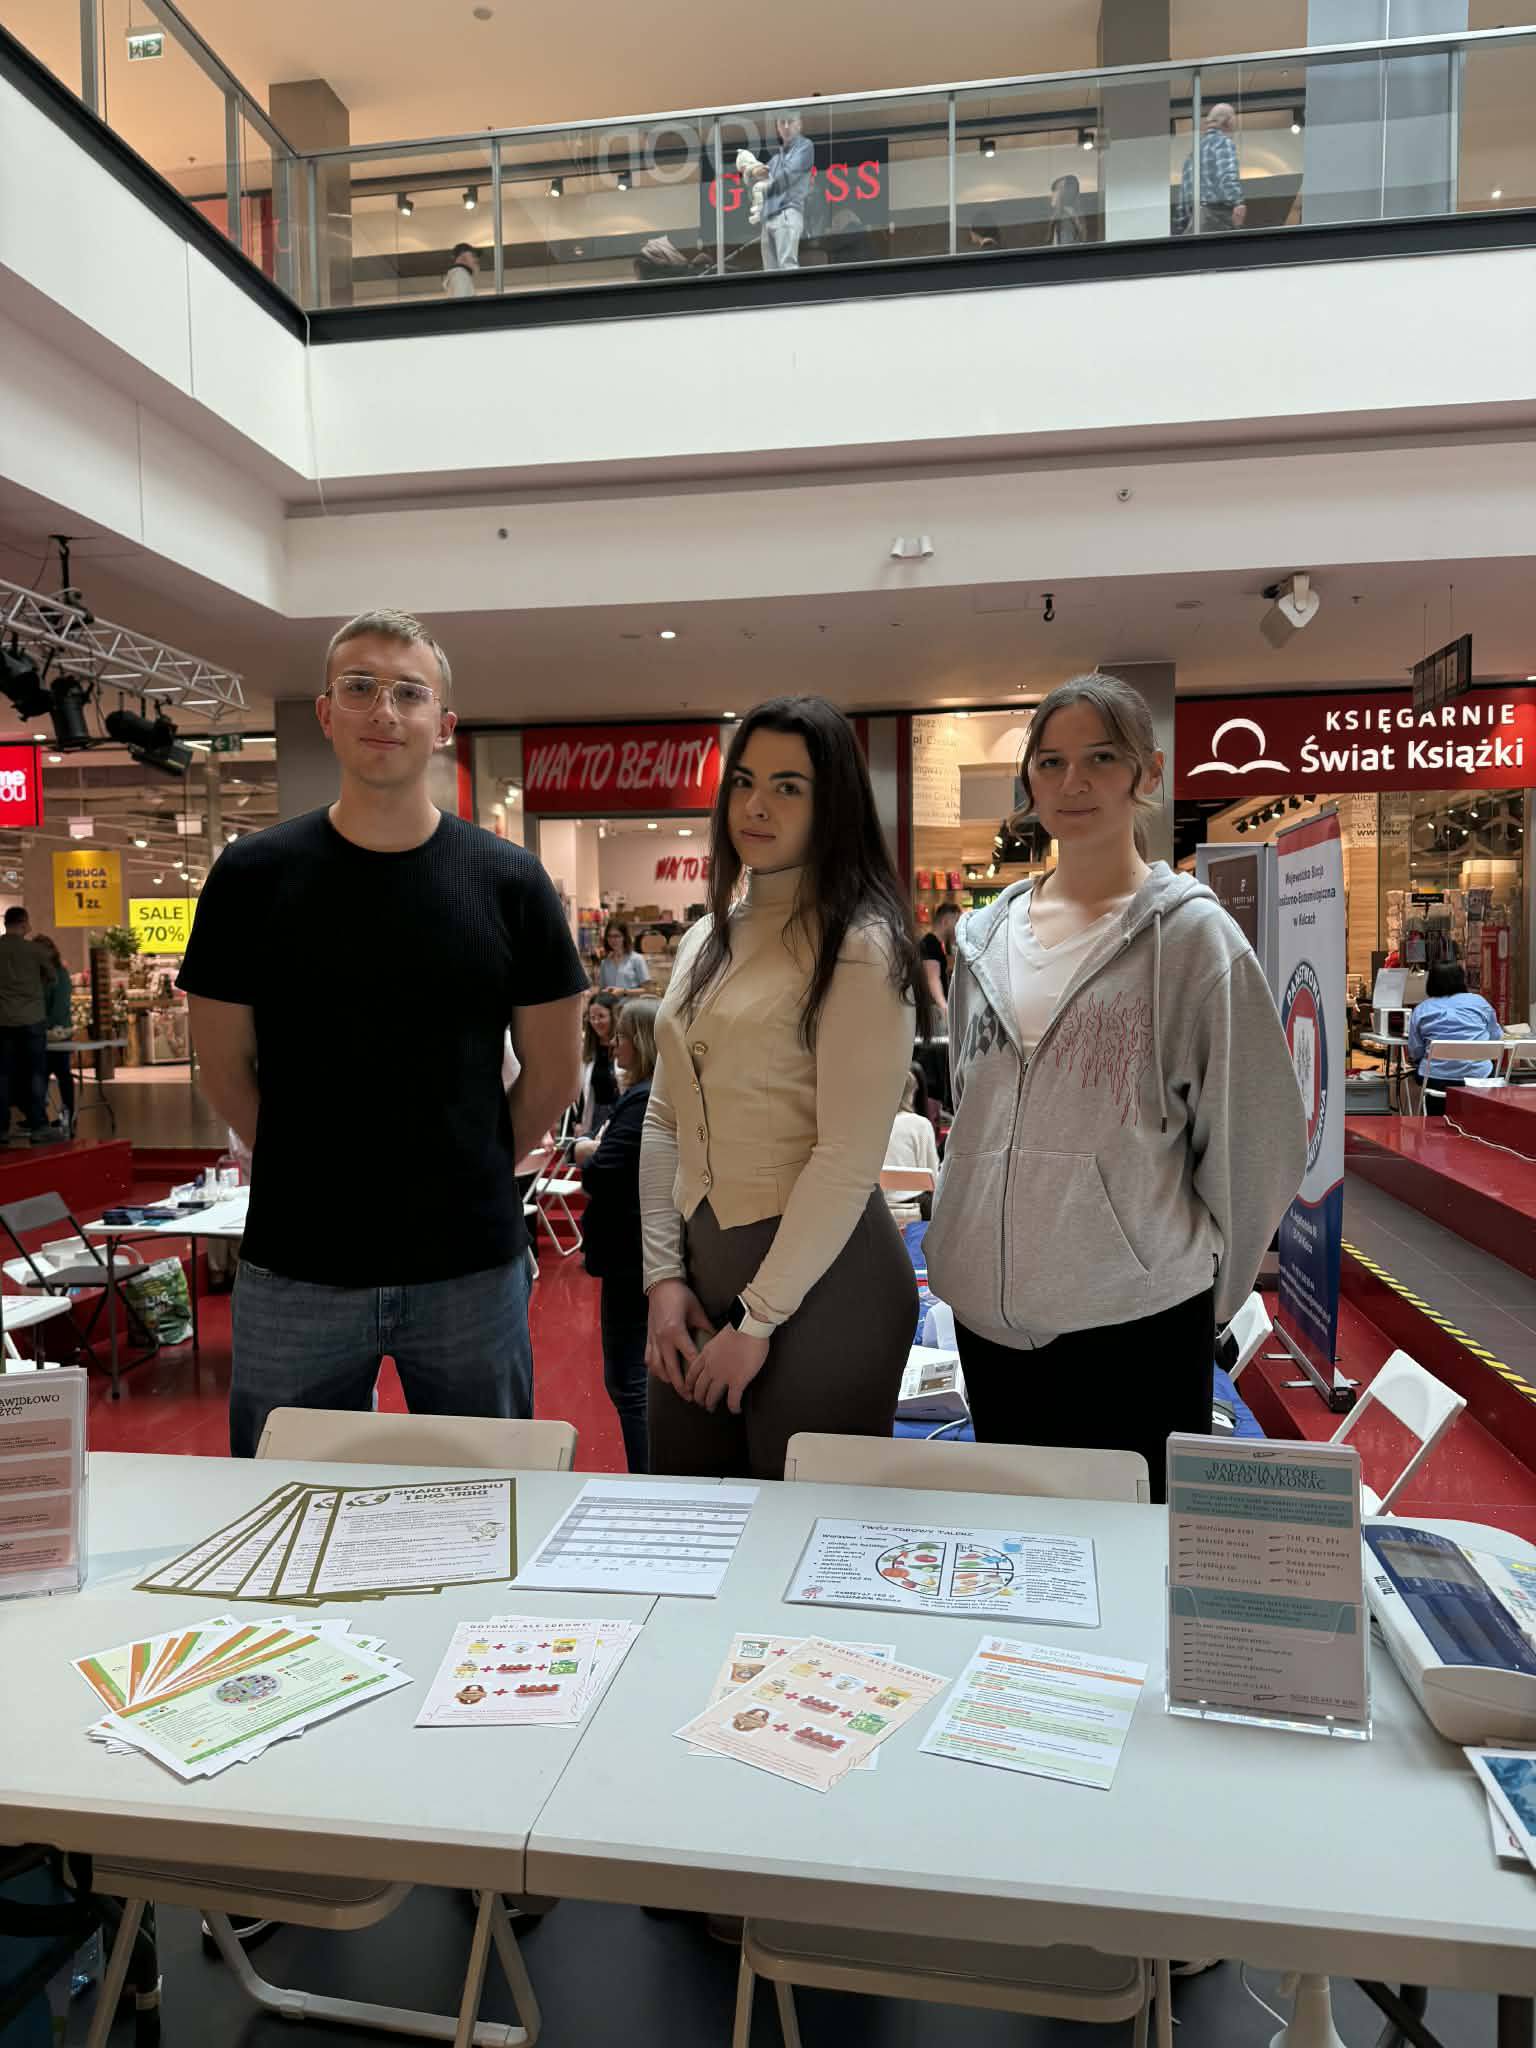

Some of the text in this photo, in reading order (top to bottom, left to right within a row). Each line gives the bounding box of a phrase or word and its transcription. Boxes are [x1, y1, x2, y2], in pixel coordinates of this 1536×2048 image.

[708, 160, 880, 212] GSS
[1326, 704, 1515, 734] KSIĘGARNIE
[525, 737, 714, 791] WAY TO BEAUTY
[1300, 735, 1523, 773] Świat Książki
[66, 868, 106, 877] DRUGA
[655, 856, 682, 881] WAY
[680, 857, 698, 881] TO
[67, 879, 108, 889] RZECZ
[75, 892, 83, 909] 1
[139, 906, 184, 921] SALE
